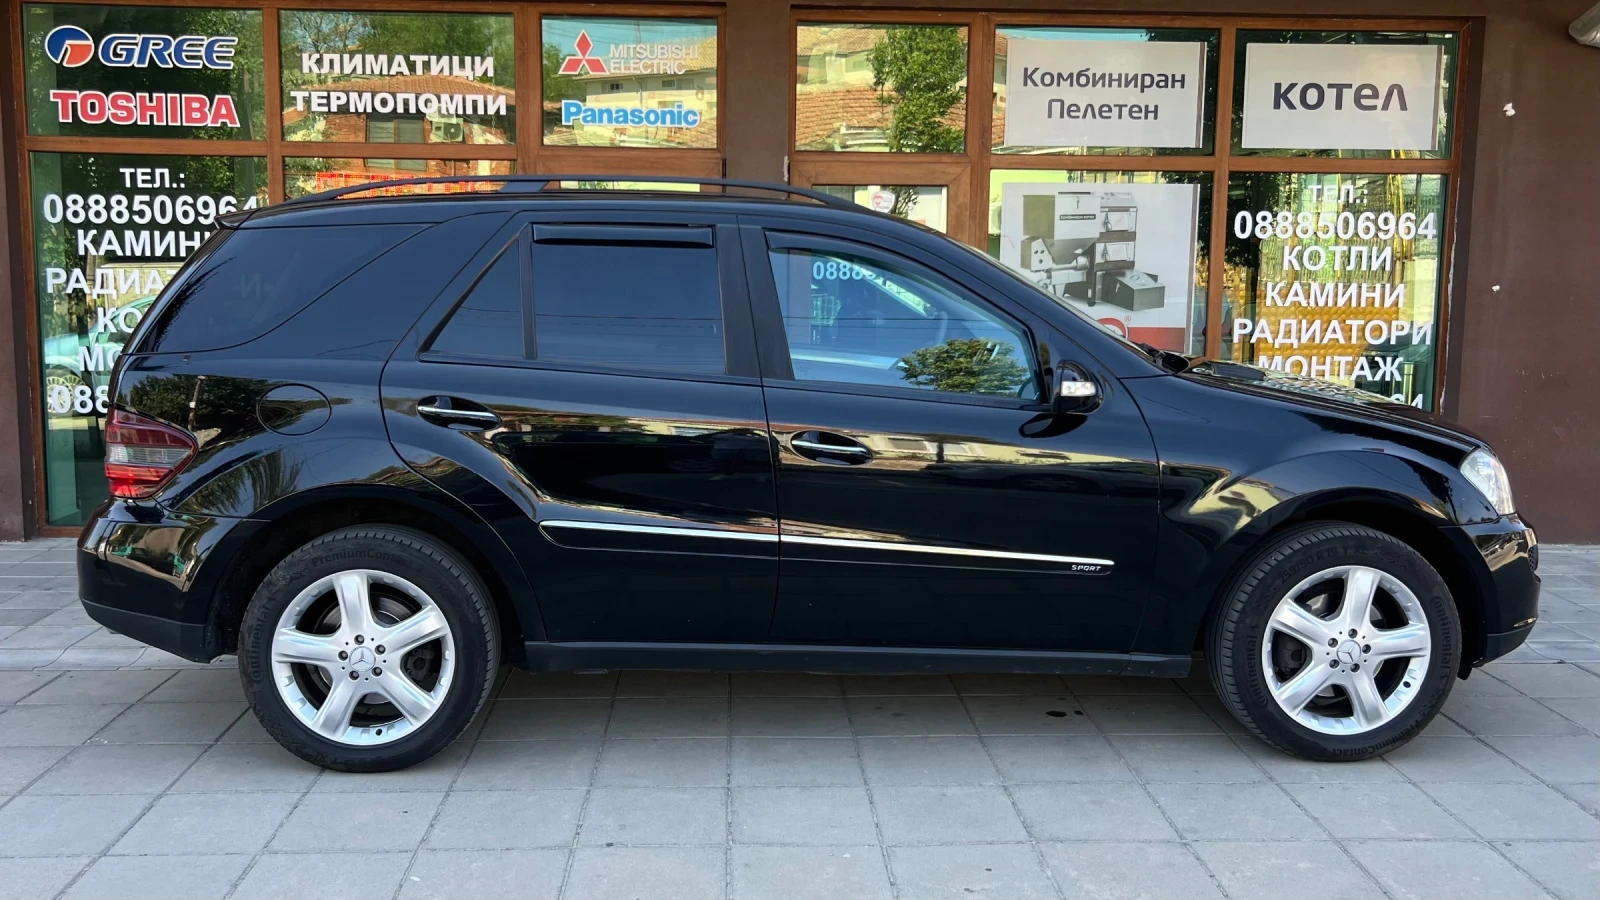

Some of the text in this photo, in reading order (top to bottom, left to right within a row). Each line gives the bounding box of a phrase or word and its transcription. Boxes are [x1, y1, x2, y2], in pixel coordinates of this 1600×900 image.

[100, 34, 238, 69] GREE
[609, 43, 699, 60] MITSUBISHI
[302, 53, 495, 79] КЛИМАТИЦИ
[609, 59, 687, 75] ELECTRIC
[1022, 66, 1186, 93] Комбиниран
[50, 90, 241, 128] TOSHIBA
[290, 91, 507, 116] ТЕРМОПОМПИ
[561, 100, 700, 128] Panasonic
[1046, 98, 1159, 121] Пелетен
[120, 168, 186, 188] ТЕЛ.:
[1308, 184, 1368, 204] ТЕЛ.:
[1234, 210, 1437, 240] 0888506964
[1283, 245, 1392, 271] КОТЛИ
[46, 267, 179, 299] РАДИА
[1265, 281, 1405, 308] КАМИНИ
[1233, 318, 1433, 348] РАДИАТОРИ
[1070, 564, 1102, 572] SPORT
